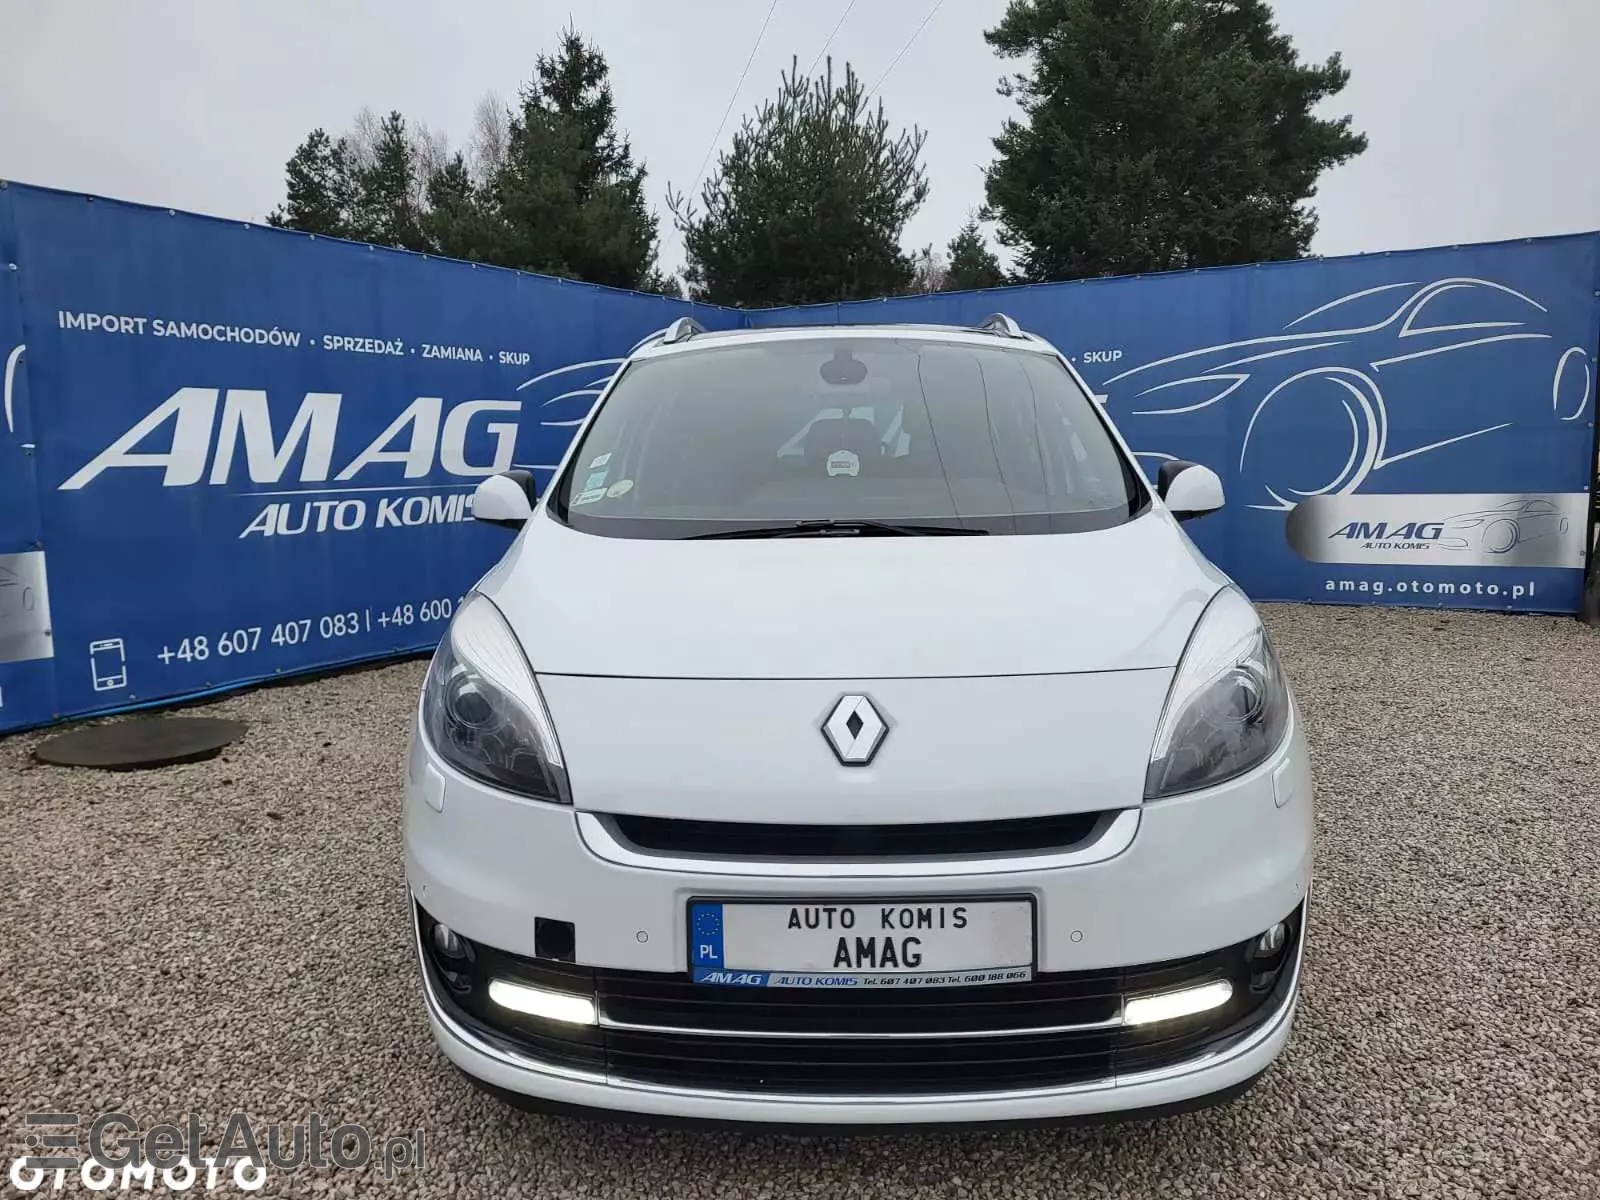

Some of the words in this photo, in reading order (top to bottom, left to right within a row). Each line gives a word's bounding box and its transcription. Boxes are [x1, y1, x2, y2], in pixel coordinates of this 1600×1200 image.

[57, 310, 148, 337] IMPORT
[152, 318, 301, 347] SAMOCHODÓW
[322, 333, 405, 356] SPRZEDAŻ
[421, 344, 484, 363] ZAMIANA
[498, 350, 531, 366] SKUP
[1083, 350, 1123, 363] SKUP
[57, 386, 523, 491] AMAG
[238, 500, 366, 539] AUTO
[1328, 521, 1445, 540] AMAG
[1360, 542, 1392, 550] AUTO
[1393, 542, 1431, 550] KOMIS
[1325, 579, 1536, 599] amag.otomoto.pl
[156, 635, 210, 665] +48
[217, 626, 261, 658] 607
[270, 618, 312, 648] 407
[319, 612, 360, 639] 083
[377, 603, 415, 629] +48
[419, 598, 452, 622] 600
[787, 907, 856, 930] AUTO
[881, 906, 968, 930] KOMIS
[699, 944, 719, 960] PL
[833, 936, 922, 969] AMAG
[702, 972, 762, 986] AMAG
[775, 976, 813, 986] AUTO
[815, 976, 858, 986] KOMIS
